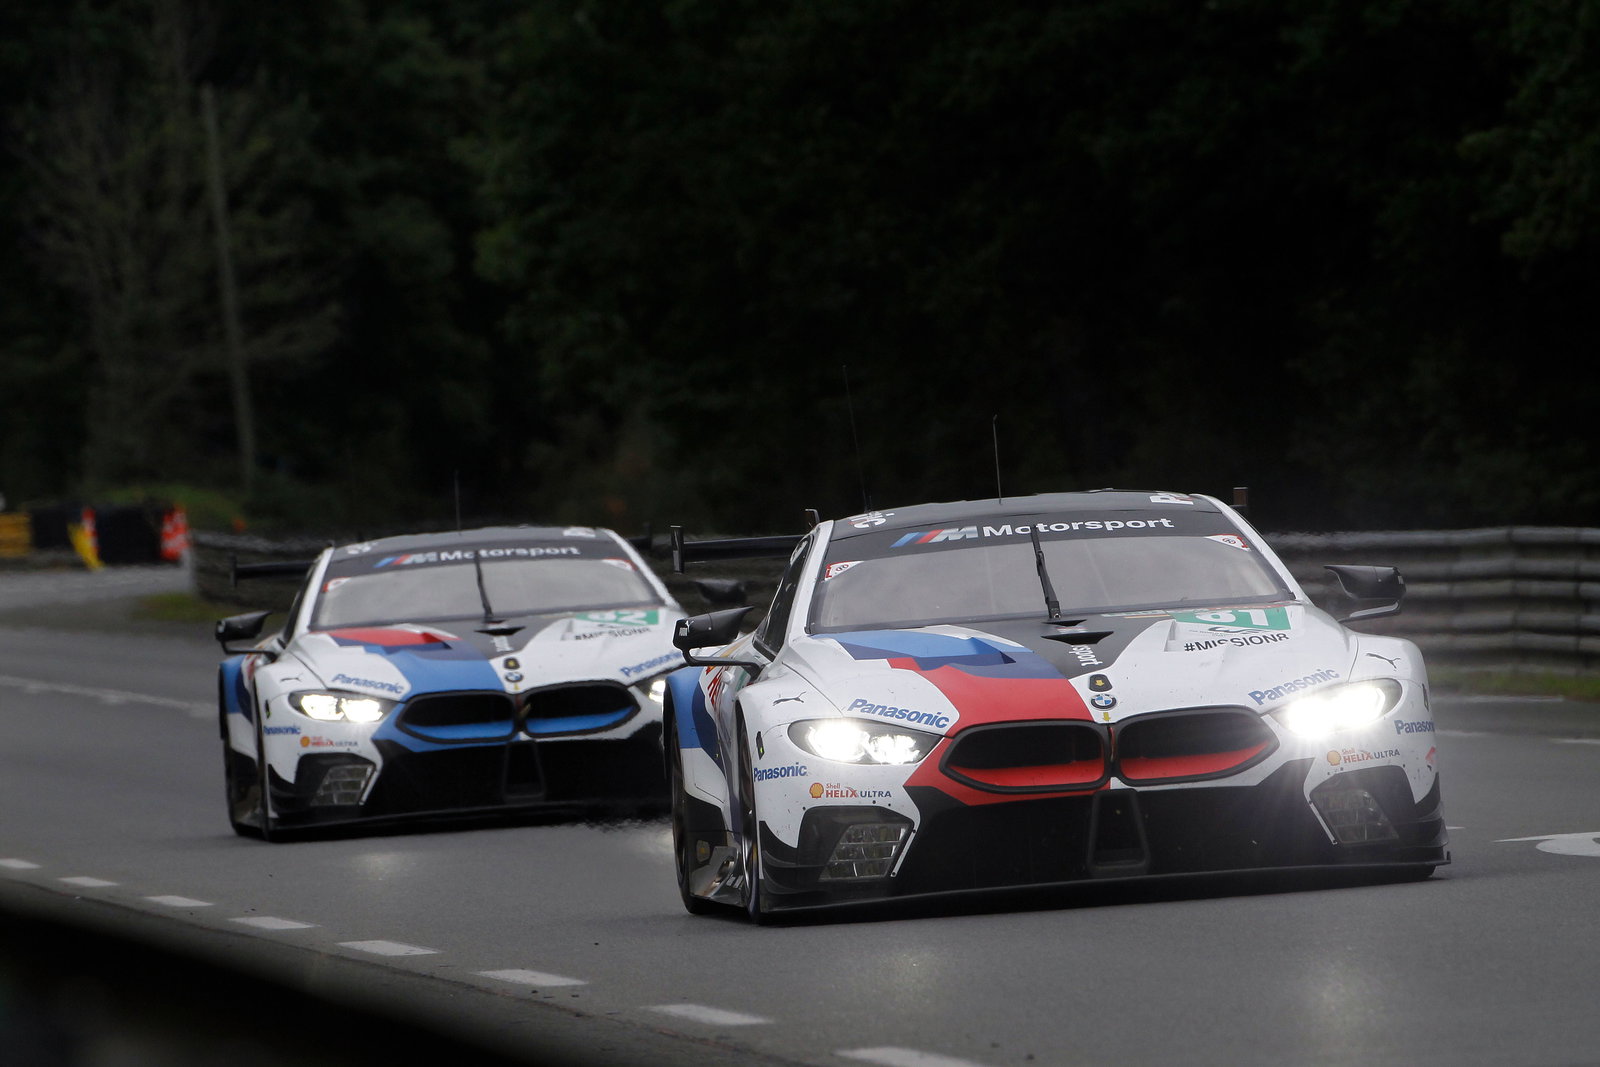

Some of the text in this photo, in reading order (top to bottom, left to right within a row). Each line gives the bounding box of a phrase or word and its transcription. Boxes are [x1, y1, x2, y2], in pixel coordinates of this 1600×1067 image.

[983, 518, 1174, 537] Motorsport
[440, 547, 580, 561] Motorsport
[332, 673, 404, 694] Panasonic
[1248, 668, 1340, 705] Panasonic
[847, 698, 950, 729] Panasonic
[1343, 748, 1401, 763] HELIX ULTRA
[753, 762, 807, 782] Panasonic
[826, 787, 892, 798] HELIX ULTRA
